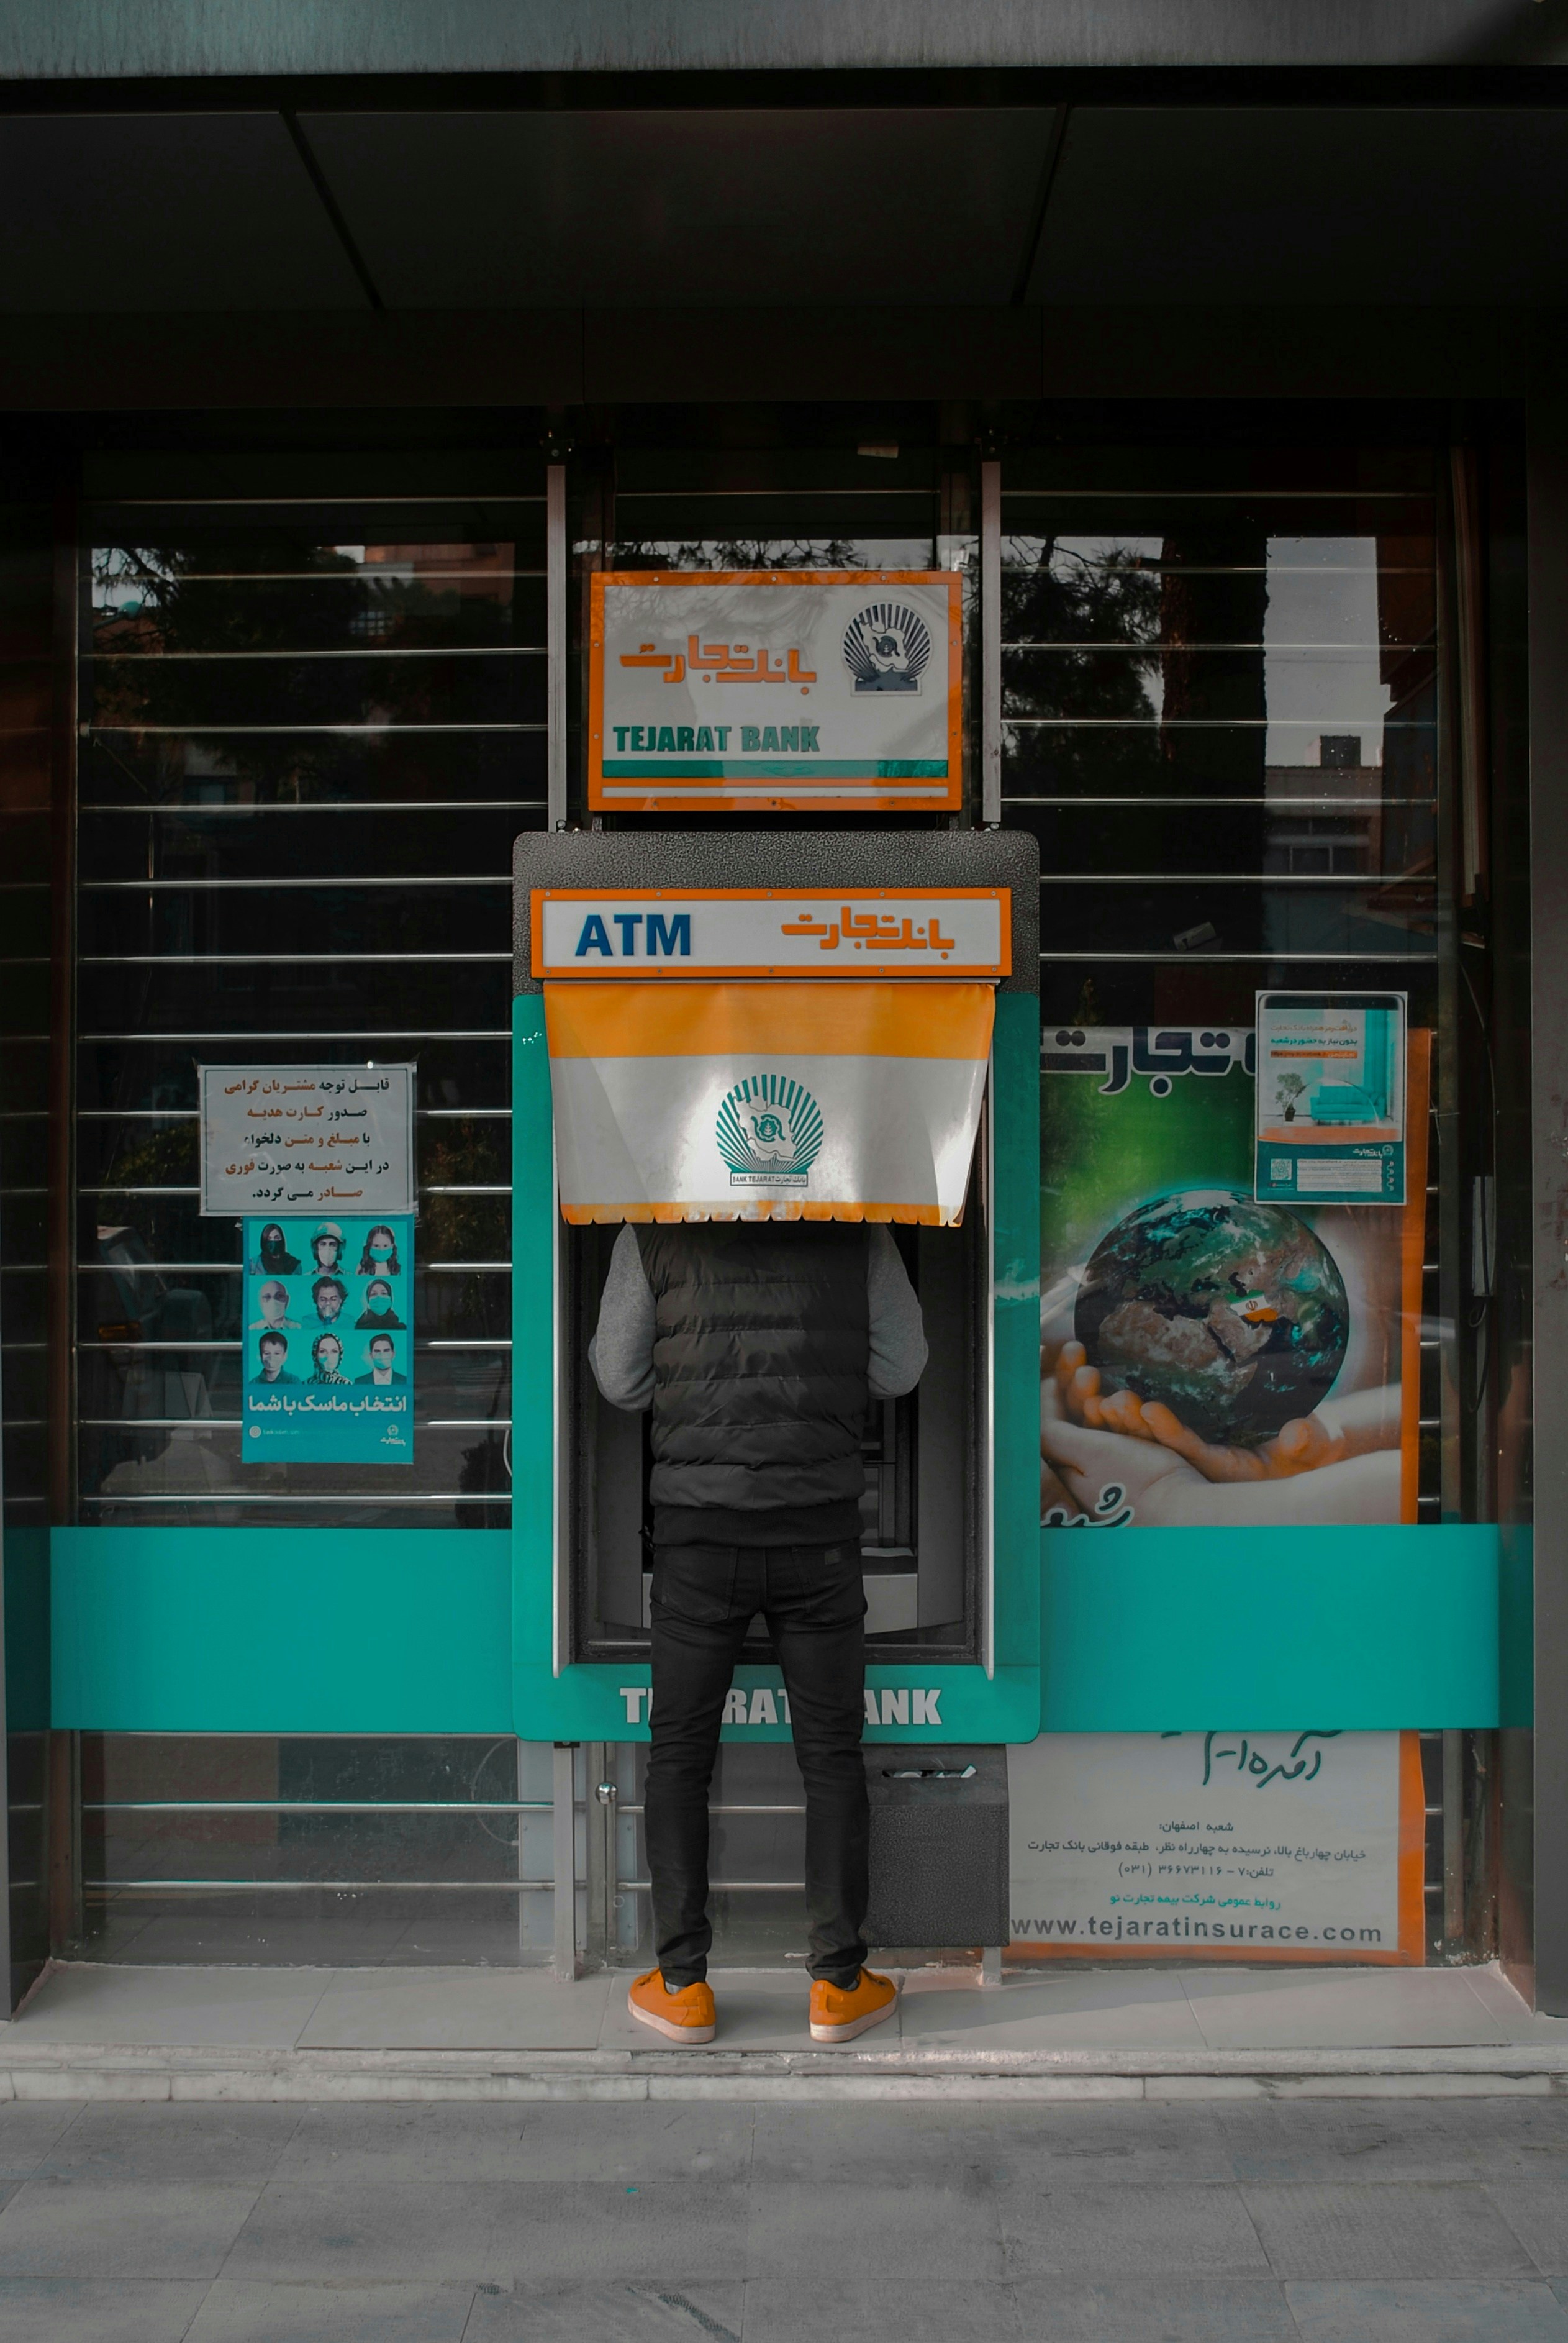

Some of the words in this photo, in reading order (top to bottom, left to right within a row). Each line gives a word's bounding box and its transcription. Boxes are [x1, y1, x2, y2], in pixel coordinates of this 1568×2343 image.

[613, 726, 732, 752] TEJARAT
[742, 726, 820, 752] BANK
[575, 914, 691, 956] ATM
[224, 1080, 260, 1094] گرامی
[262, 1079, 315, 1094] مشتریان
[319, 1079, 345, 1094] توجه
[348, 1078, 390, 1094] قابل
[247, 1108, 283, 1121] هدیه
[286, 1106, 324, 1121] کارت
[329, 1109, 367, 1121] صدور
[284, 1134, 314, 1147] متن
[317, 1138, 324, 1148] و
[327, 1132, 360, 1148] مبلغ
[363, 1132, 370, 1144] با
[225, 1158, 255, 1175] فوری
[258, 1161, 291, 1174] صورت
[294, 1162, 305, 1173] به
[309, 1160, 343, 1175] شعبه
[346, 1159, 373, 1174] این
[376, 1163, 389, 1175] در
[287, 1190, 314, 1201] می
[317, 1186, 363, 1201] صادر
[248, 1394, 281, 1412] شما
[283, 1396, 296, 1416] با
[297, 1395, 348, 1412] ماسک
[349, 1396, 407, 1416] انتخاب
[620, 1687, 791, 1724] TRAT
[863, 1688, 942, 1725] ANK
[1159, 1821, 1200, 1832] اصفهان:
[1206, 1822, 1234, 1833] شعبه
[1028, 1840, 1059, 1853] تجارت
[1063, 1840, 1085, 1853] بانک
[1088, 1841, 1122, 1853] فوقانی
[1125, 1842, 1149, 1854] طبقه
[1218, 1846, 1229, 1855] به
[1232, 1845, 1271, 1857] نرسیده
[1334, 1850, 1366, 1862] خیابان
[1110, 1894, 1120, 1905] نو
[1123, 1894, 1154, 1905] تجارت
[1157, 1896, 1179, 1906] بیمه
[1181, 1893, 1216, 1906] شرکت
[1218, 1897, 1251, 1908] عمومی
[1253, 1897, 1281, 1910] روابط
[1011, 1916, 1382, 1942] www.tejaratinsurace.com
